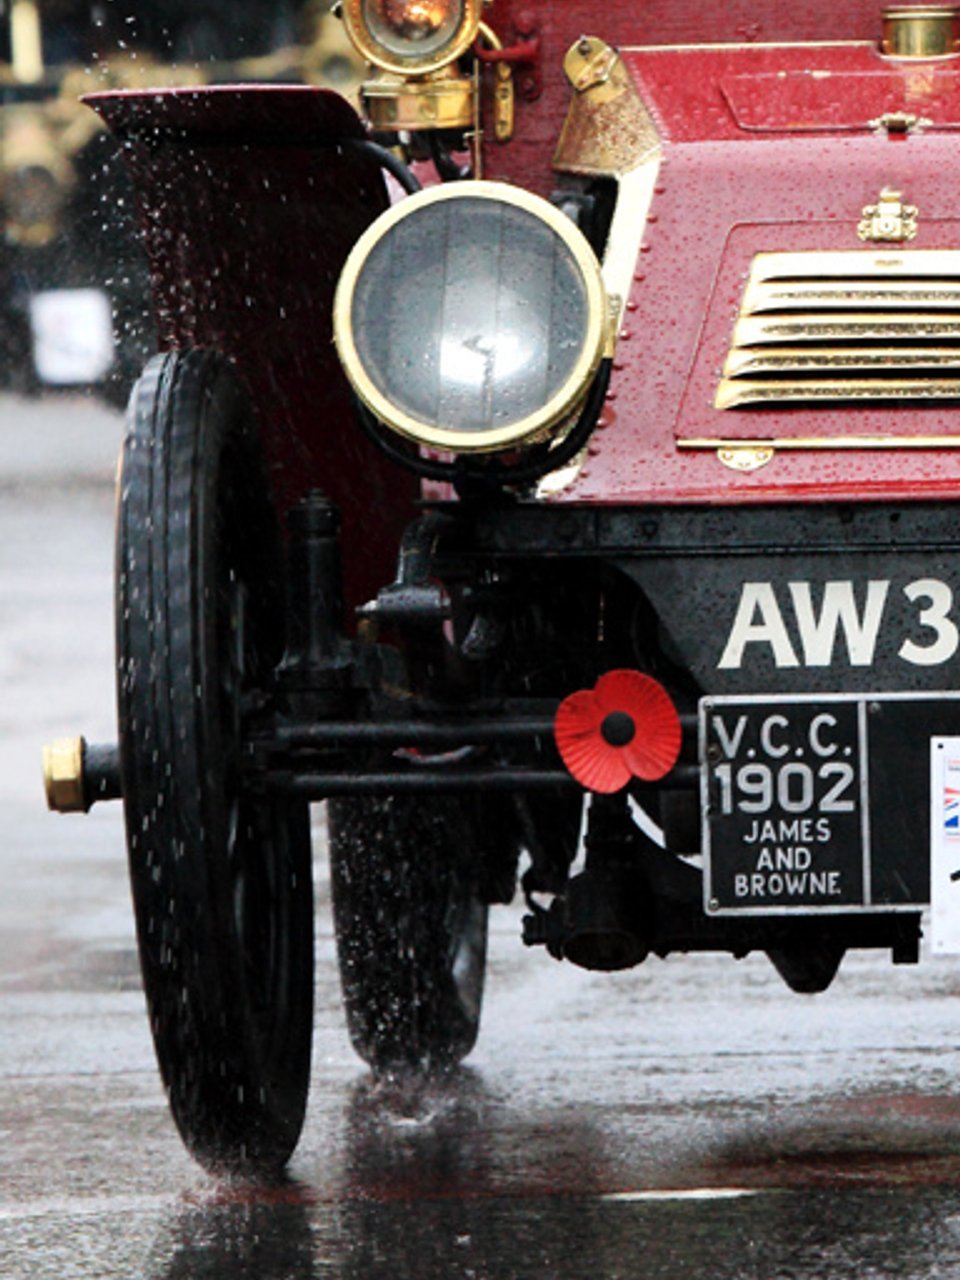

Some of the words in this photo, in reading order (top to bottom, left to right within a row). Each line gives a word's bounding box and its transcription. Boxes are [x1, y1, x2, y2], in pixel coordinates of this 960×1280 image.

[714, 762, 856, 814] 1902
[743, 818, 832, 843] JAMES
[756, 847, 812, 871] AND
[735, 871, 842, 897] BROWNE
